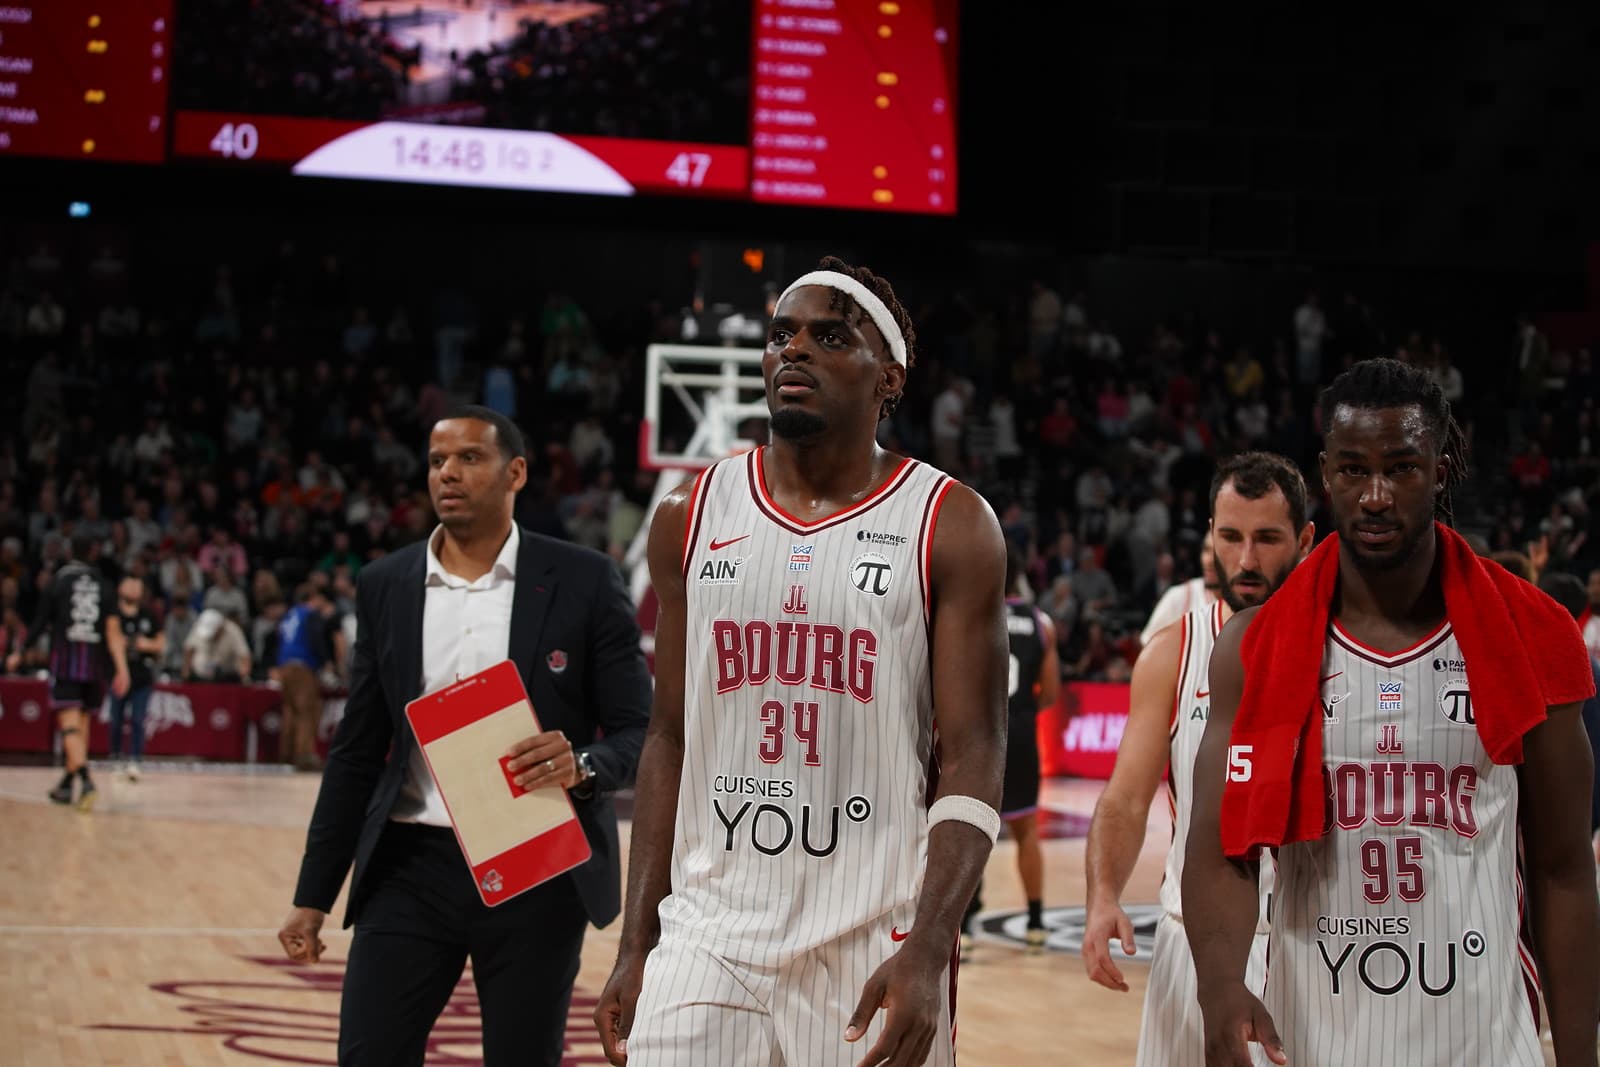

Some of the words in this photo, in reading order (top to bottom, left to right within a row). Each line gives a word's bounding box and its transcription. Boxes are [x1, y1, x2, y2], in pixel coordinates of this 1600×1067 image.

[211, 123, 259, 159] 40
[393, 135, 487, 174] 14:48
[665, 152, 712, 188] 47
[872, 532, 908, 544] PAPREC
[699, 560, 737, 579] AIN
[783, 585, 808, 614] JL
[712, 620, 880, 704] BOURG
[758, 700, 821, 766] 34
[1376, 724, 1404, 754] JL
[1226, 745, 1253, 783] 5
[713, 799, 840, 858] YOU
[1360, 836, 1426, 905] 95
[1317, 916, 1410, 936] CUISINES
[1316, 939, 1457, 997] YOU
